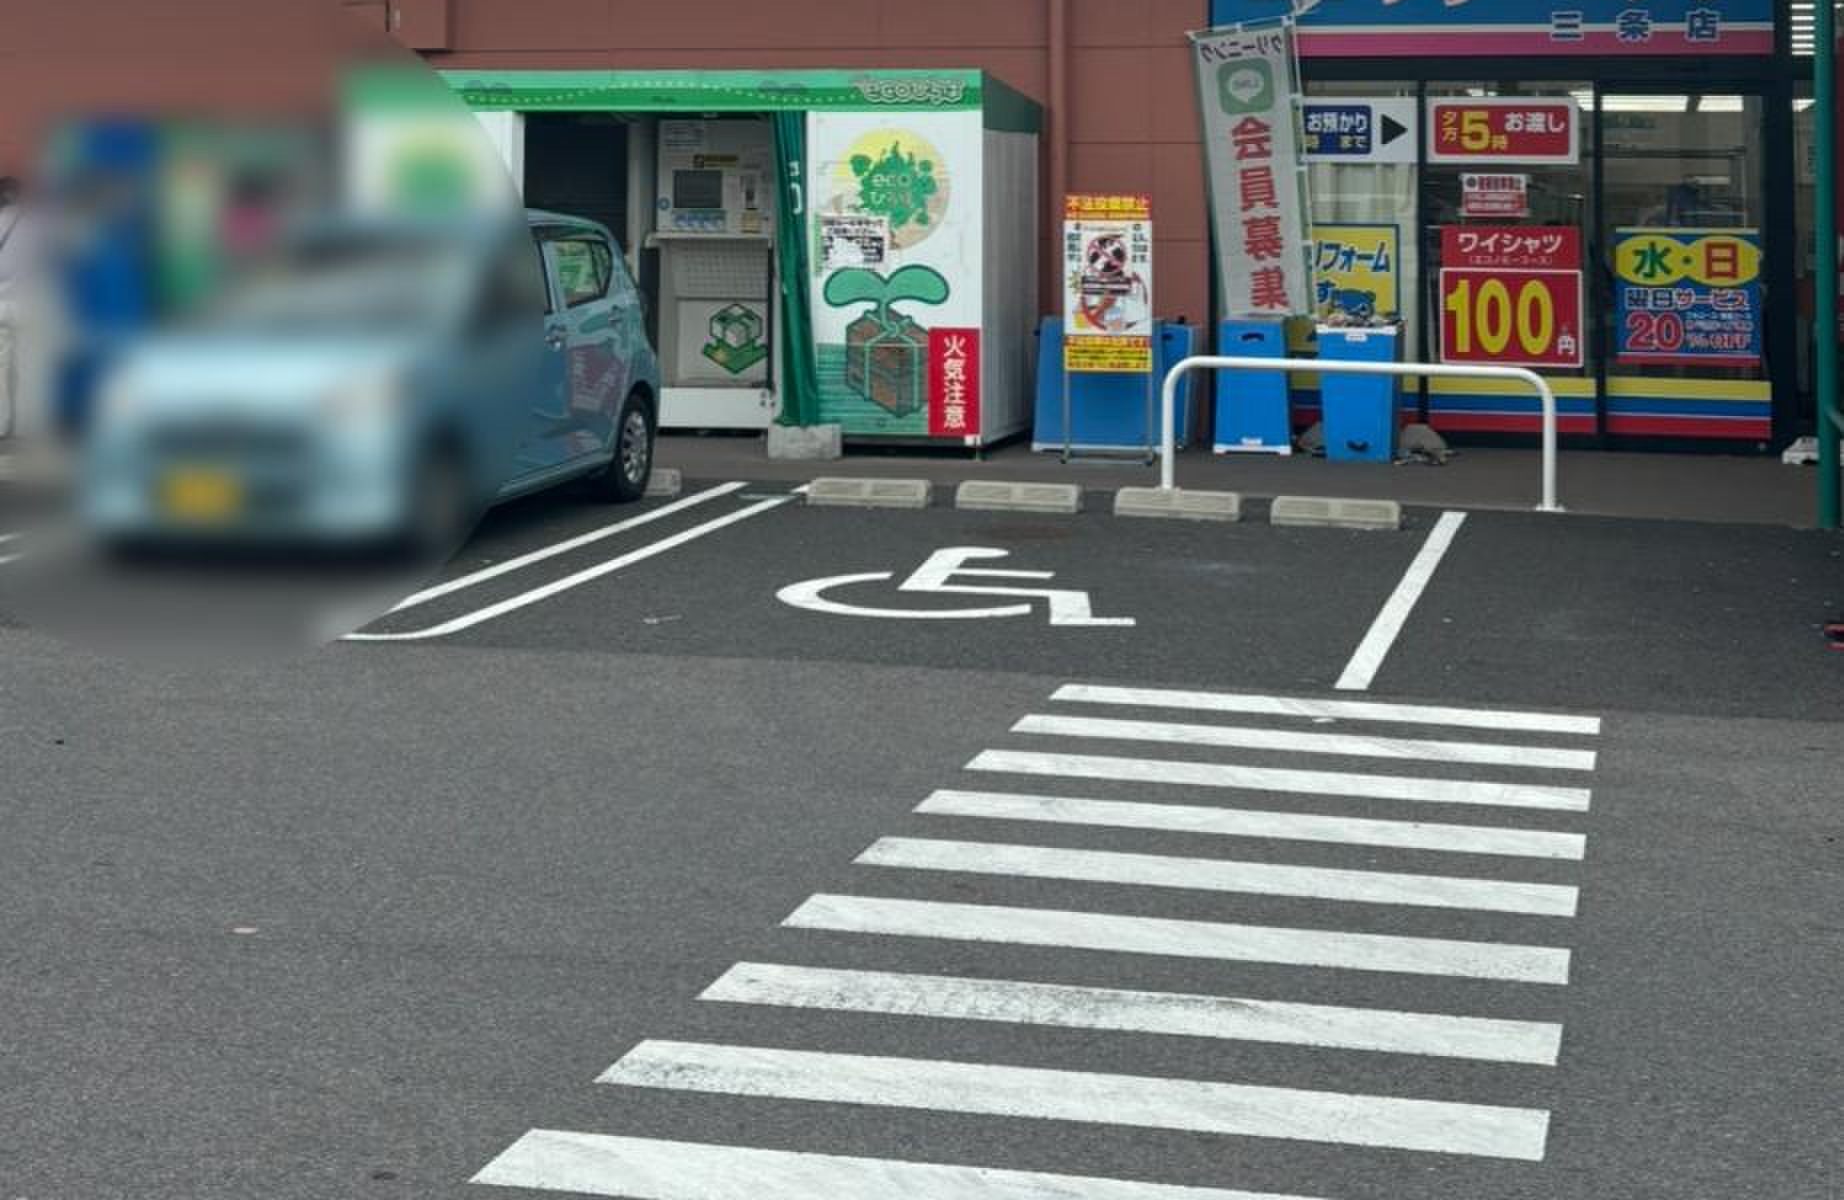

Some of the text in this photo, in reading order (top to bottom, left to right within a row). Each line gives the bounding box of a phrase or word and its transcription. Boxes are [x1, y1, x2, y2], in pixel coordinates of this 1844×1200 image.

[1550, 9, 1722, 42] 三条店
[1503, 111, 1566, 133] お渡し
[1457, 233, 1563, 254] ワイシャツ
[1632, 240, 1739, 279] 水・日
[942, 334, 967, 431] 火気注意
